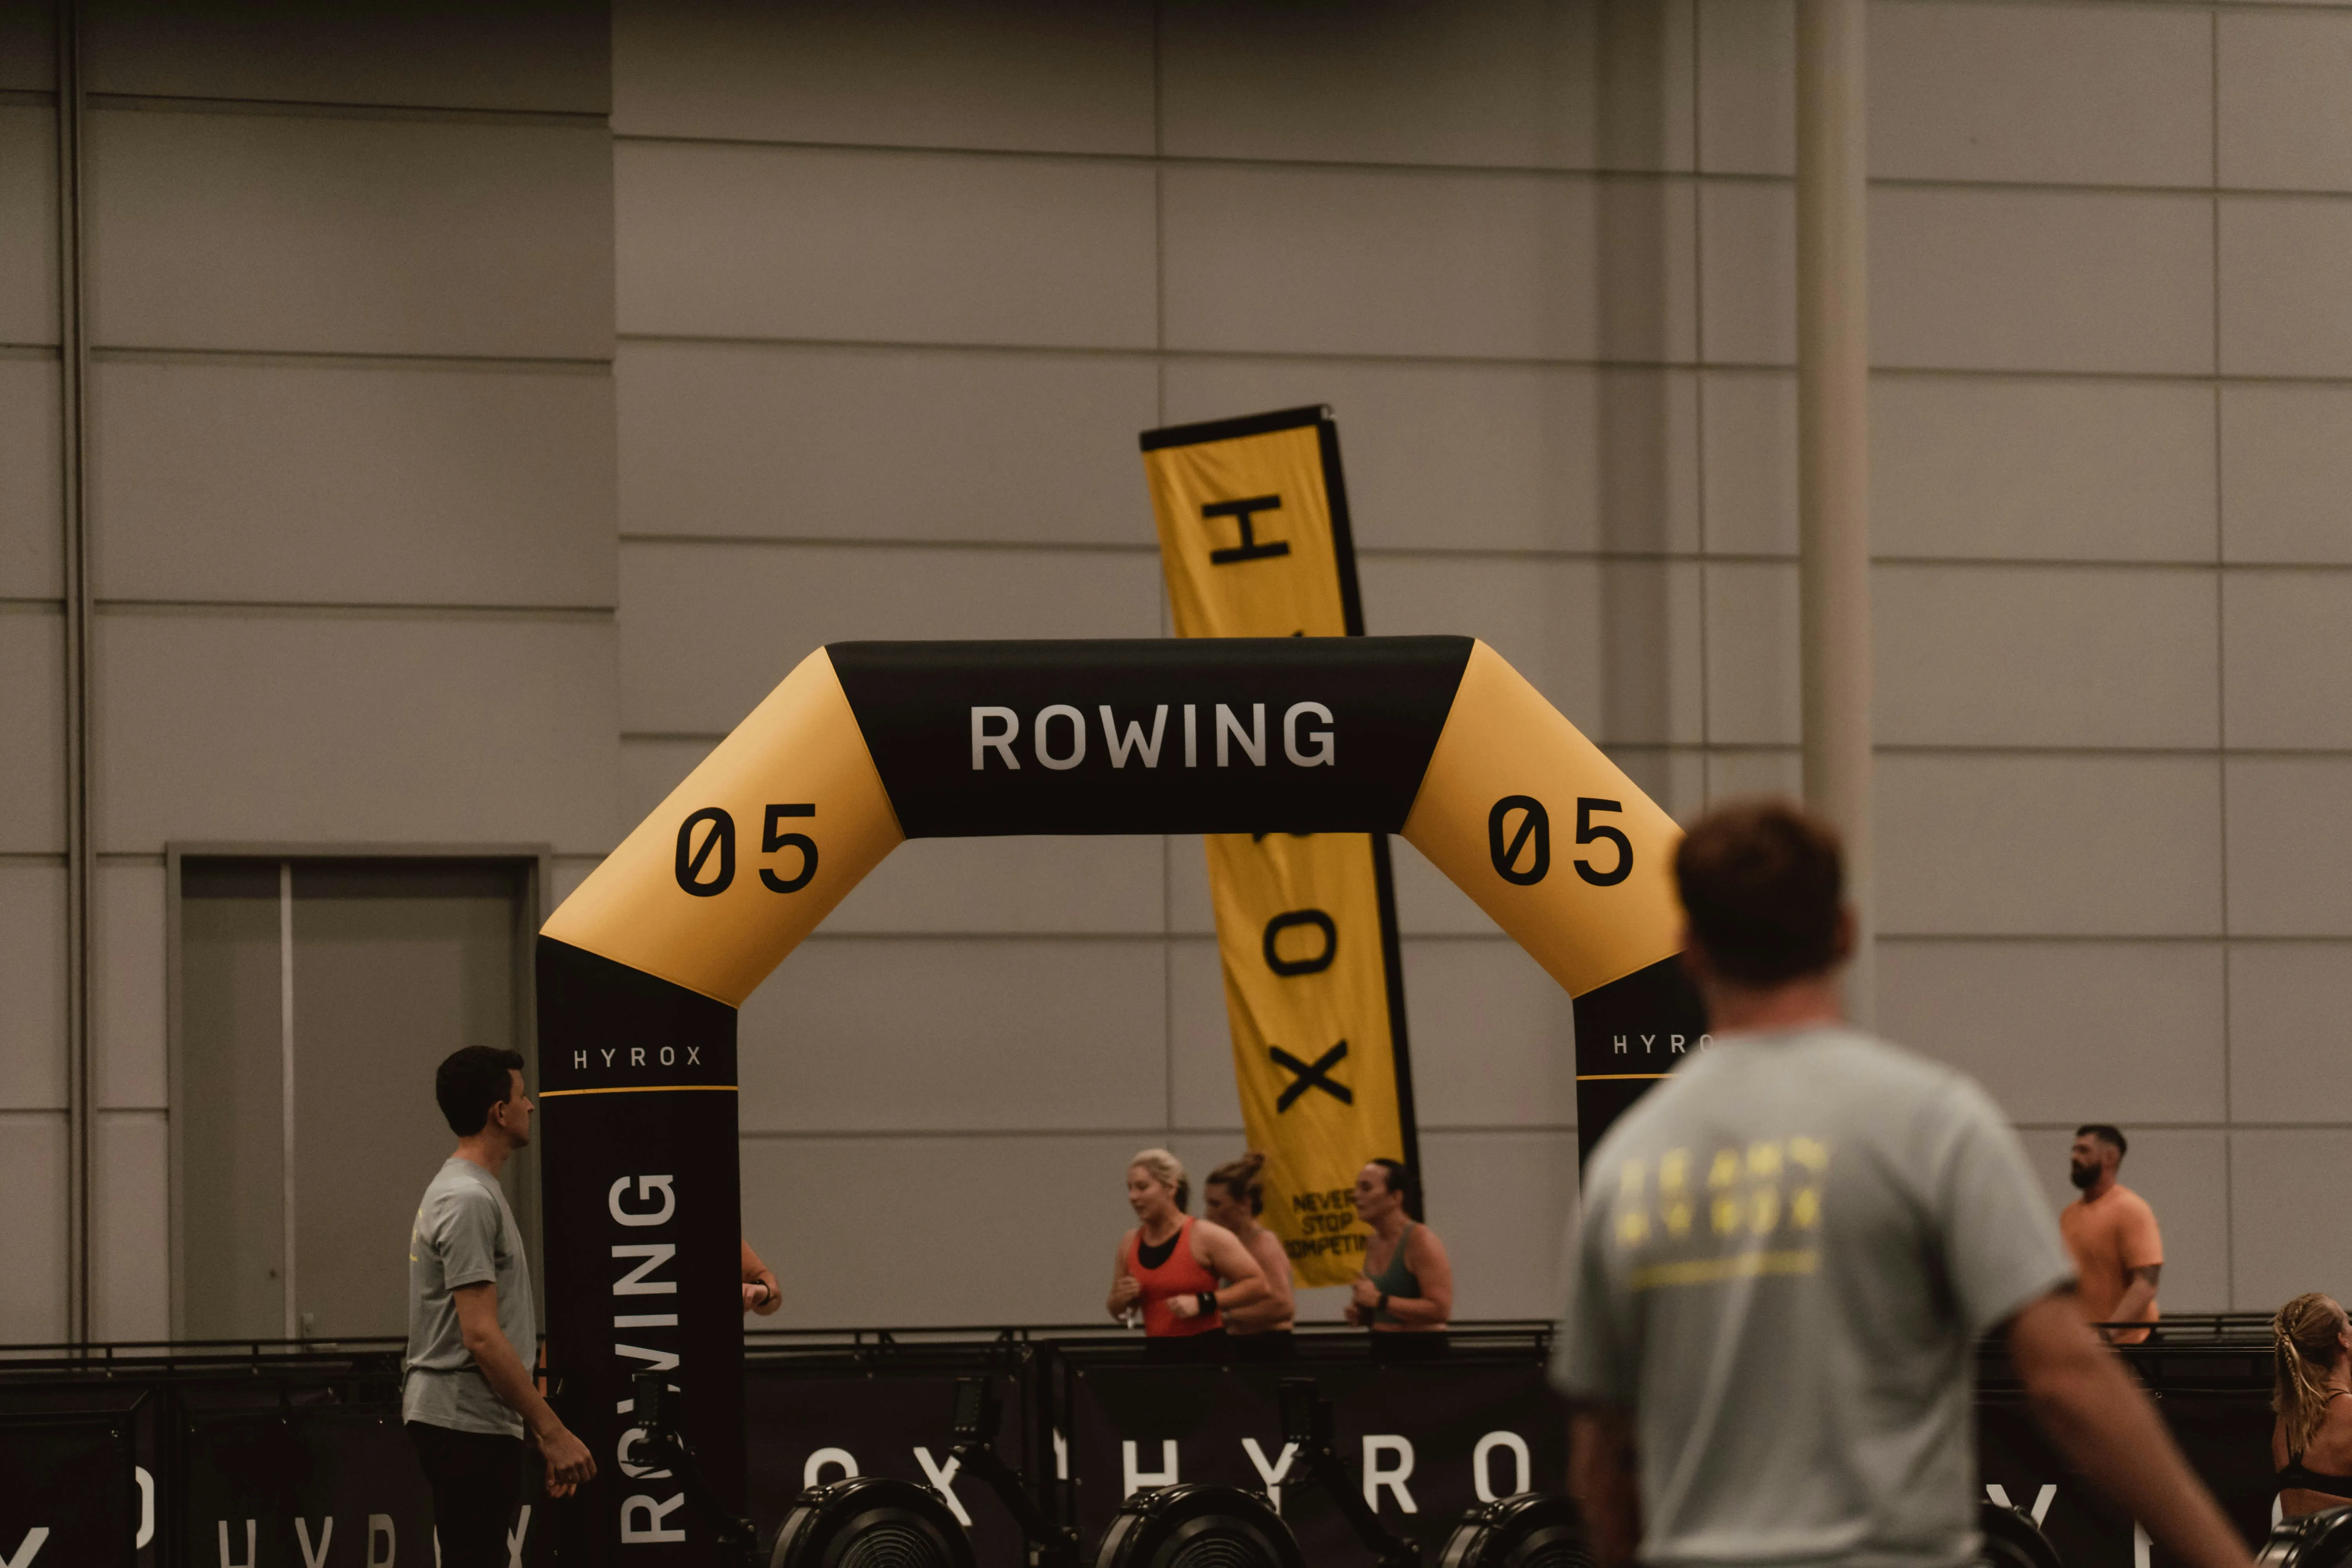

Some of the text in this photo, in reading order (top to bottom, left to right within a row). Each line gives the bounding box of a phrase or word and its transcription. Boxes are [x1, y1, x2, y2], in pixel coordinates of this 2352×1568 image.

[971, 701, 1334, 770] ROWING
[1201, 495, 1354, 1114] HOX
[675, 803, 819, 898] 05
[1488, 795, 1634, 887] 05
[574, 1046, 701, 1069] HYROX
[1613, 1034, 1714, 1054] HYRO
[1284, 1234, 1367, 1259] OMPETI
[1302, 1212, 1353, 1235] STOP
[1122, 1430, 1530, 1515] HYRO
